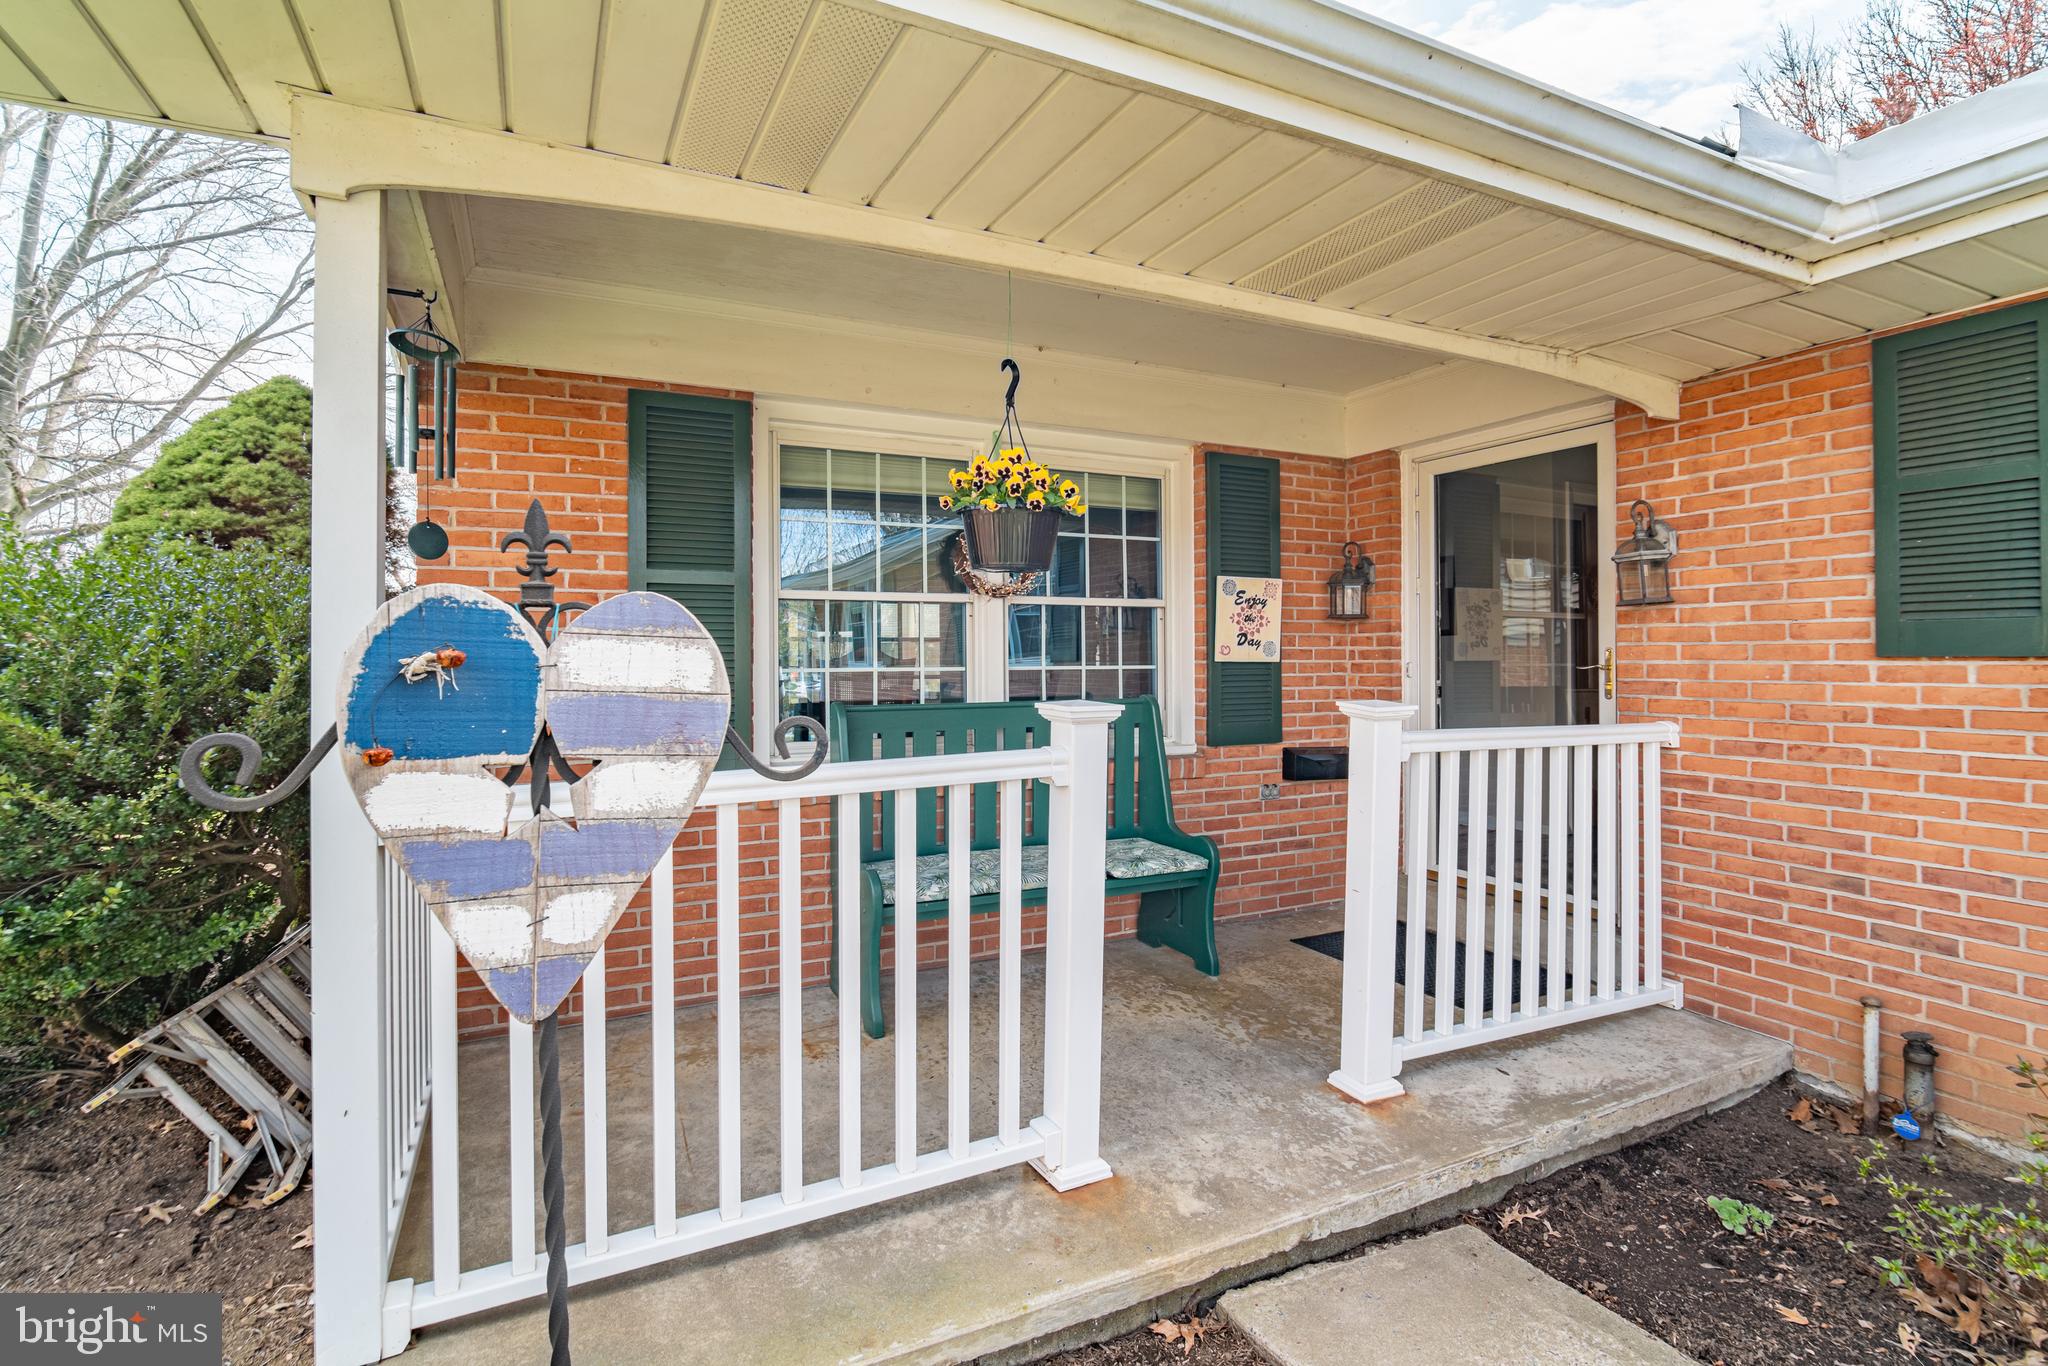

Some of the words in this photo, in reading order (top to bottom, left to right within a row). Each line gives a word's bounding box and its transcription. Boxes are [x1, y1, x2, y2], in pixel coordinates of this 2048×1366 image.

[1234, 590, 1268, 610] Enjoy
[1243, 612, 1257, 623] the
[1236, 632, 1262, 651] Day
